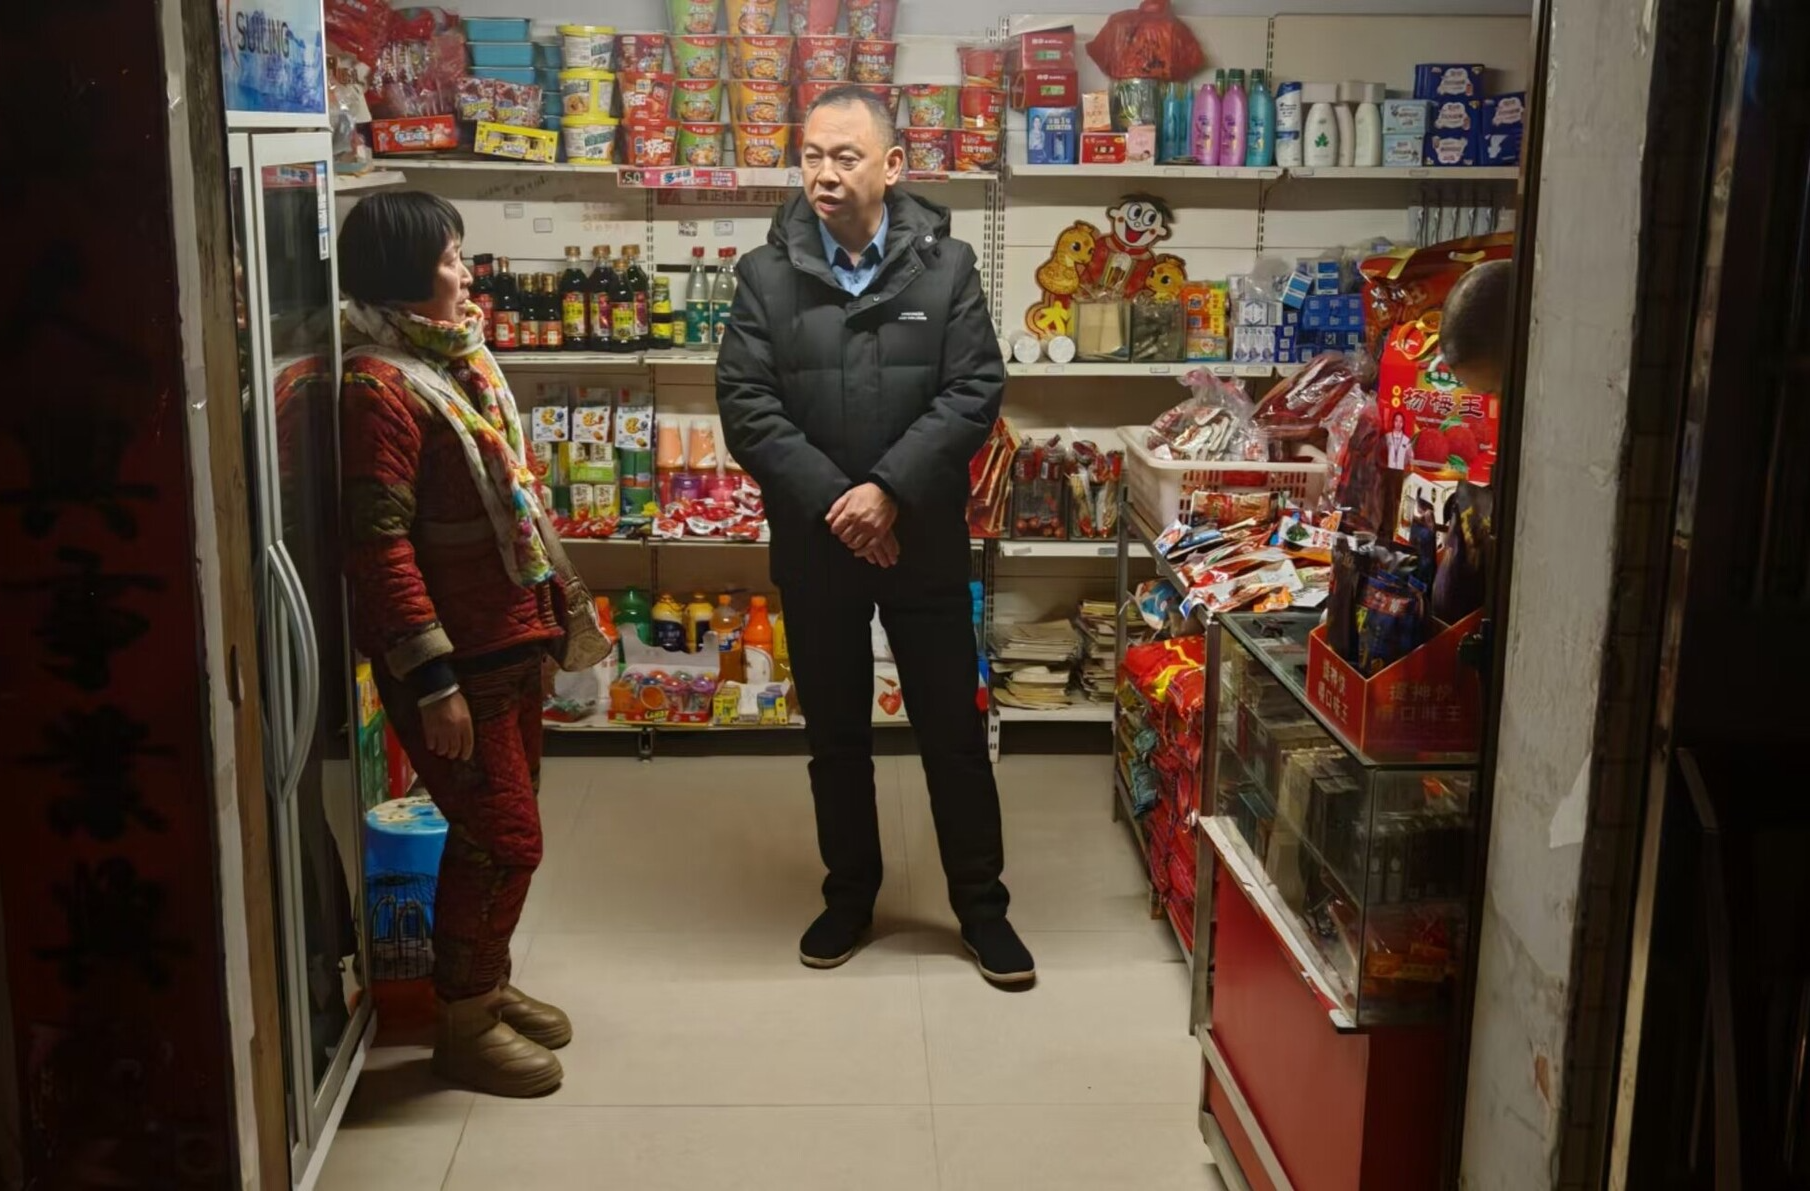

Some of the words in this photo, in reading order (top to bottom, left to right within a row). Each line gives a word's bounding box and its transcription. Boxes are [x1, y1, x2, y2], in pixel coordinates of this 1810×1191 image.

[235, 11, 291, 58] SUILING
[1402, 387, 1485, 419] 杨梅王
